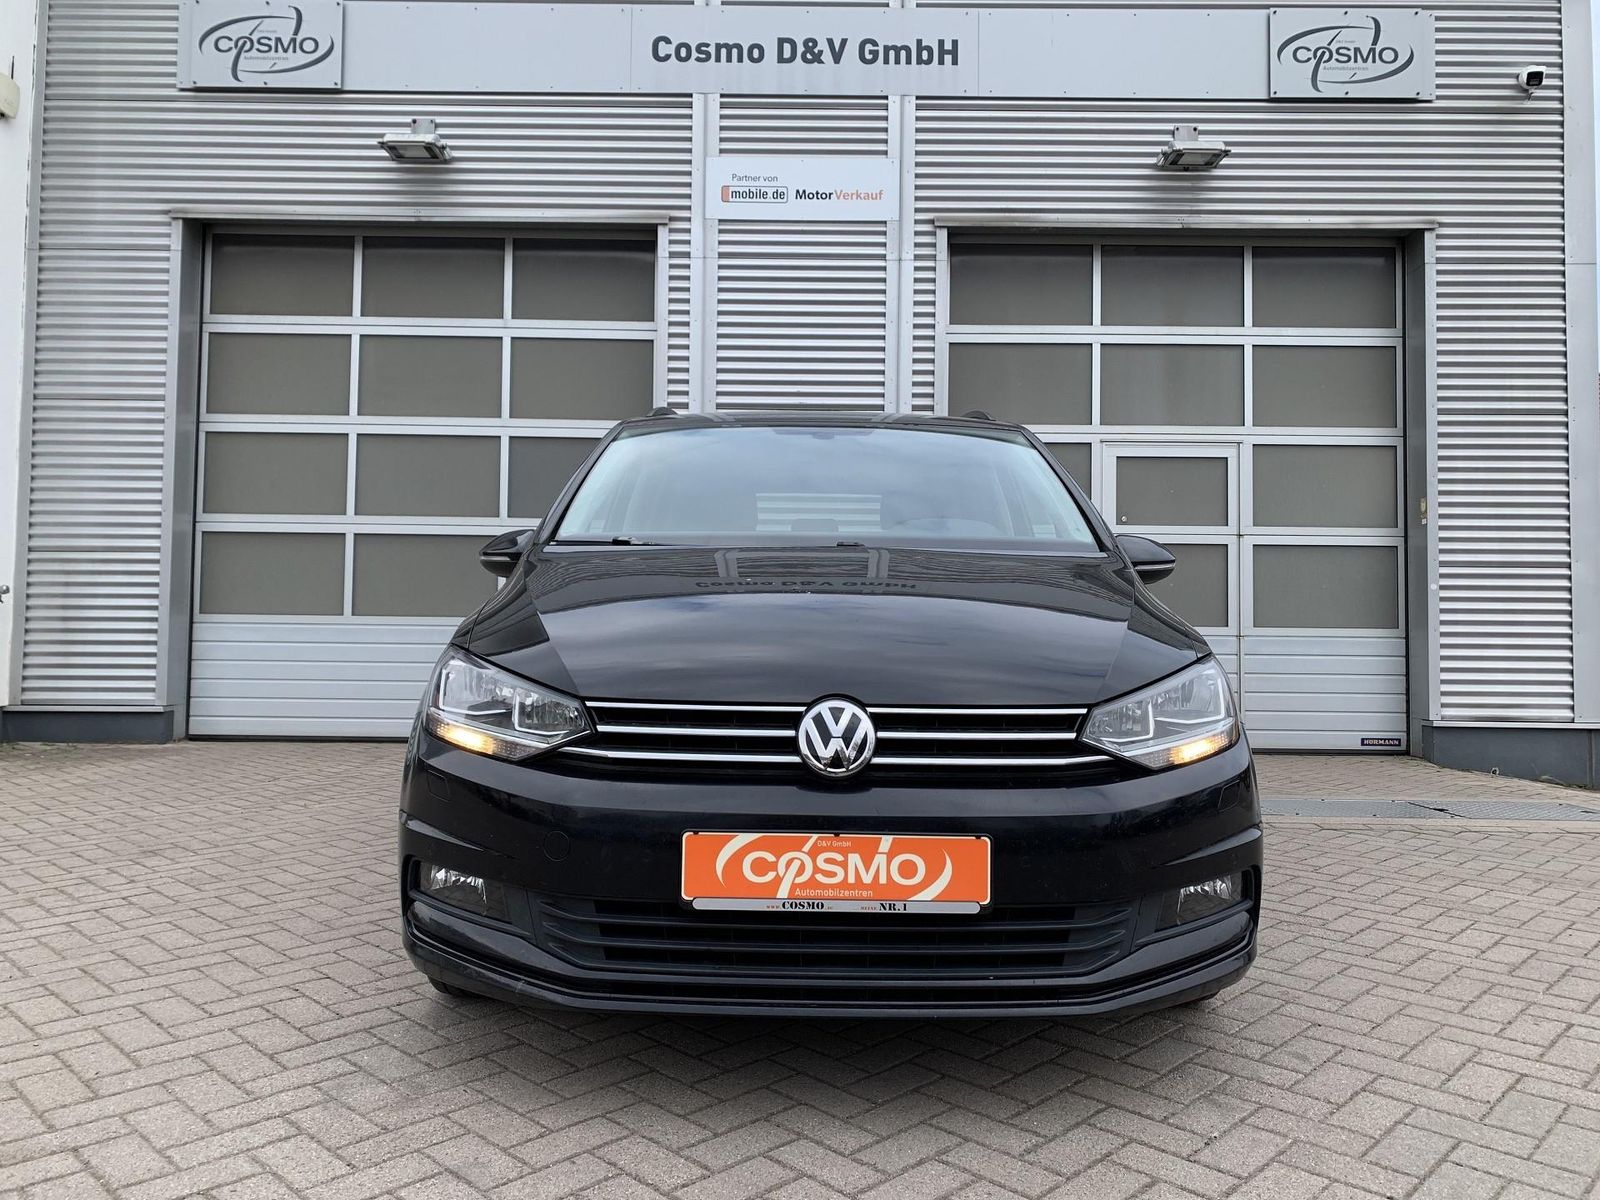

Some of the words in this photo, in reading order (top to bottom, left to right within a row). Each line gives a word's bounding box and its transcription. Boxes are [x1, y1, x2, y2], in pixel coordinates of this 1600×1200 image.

[213, 35, 319, 54] COSMO
[651, 35, 765, 64] Cosmo
[776, 37, 849, 65] D&V
[858, 38, 959, 66] GmbH
[1292, 46, 1399, 64] COSMO
[731, 173, 761, 182] Partner
[730, 188, 786, 200] mobile.de
[803, 702, 871, 772] VW
[817, 840, 831, 848] D&V
[831, 840, 852, 848] GmbH
[742, 850, 926, 886] COSMO
[795, 887, 873, 898] Automobilzentren
